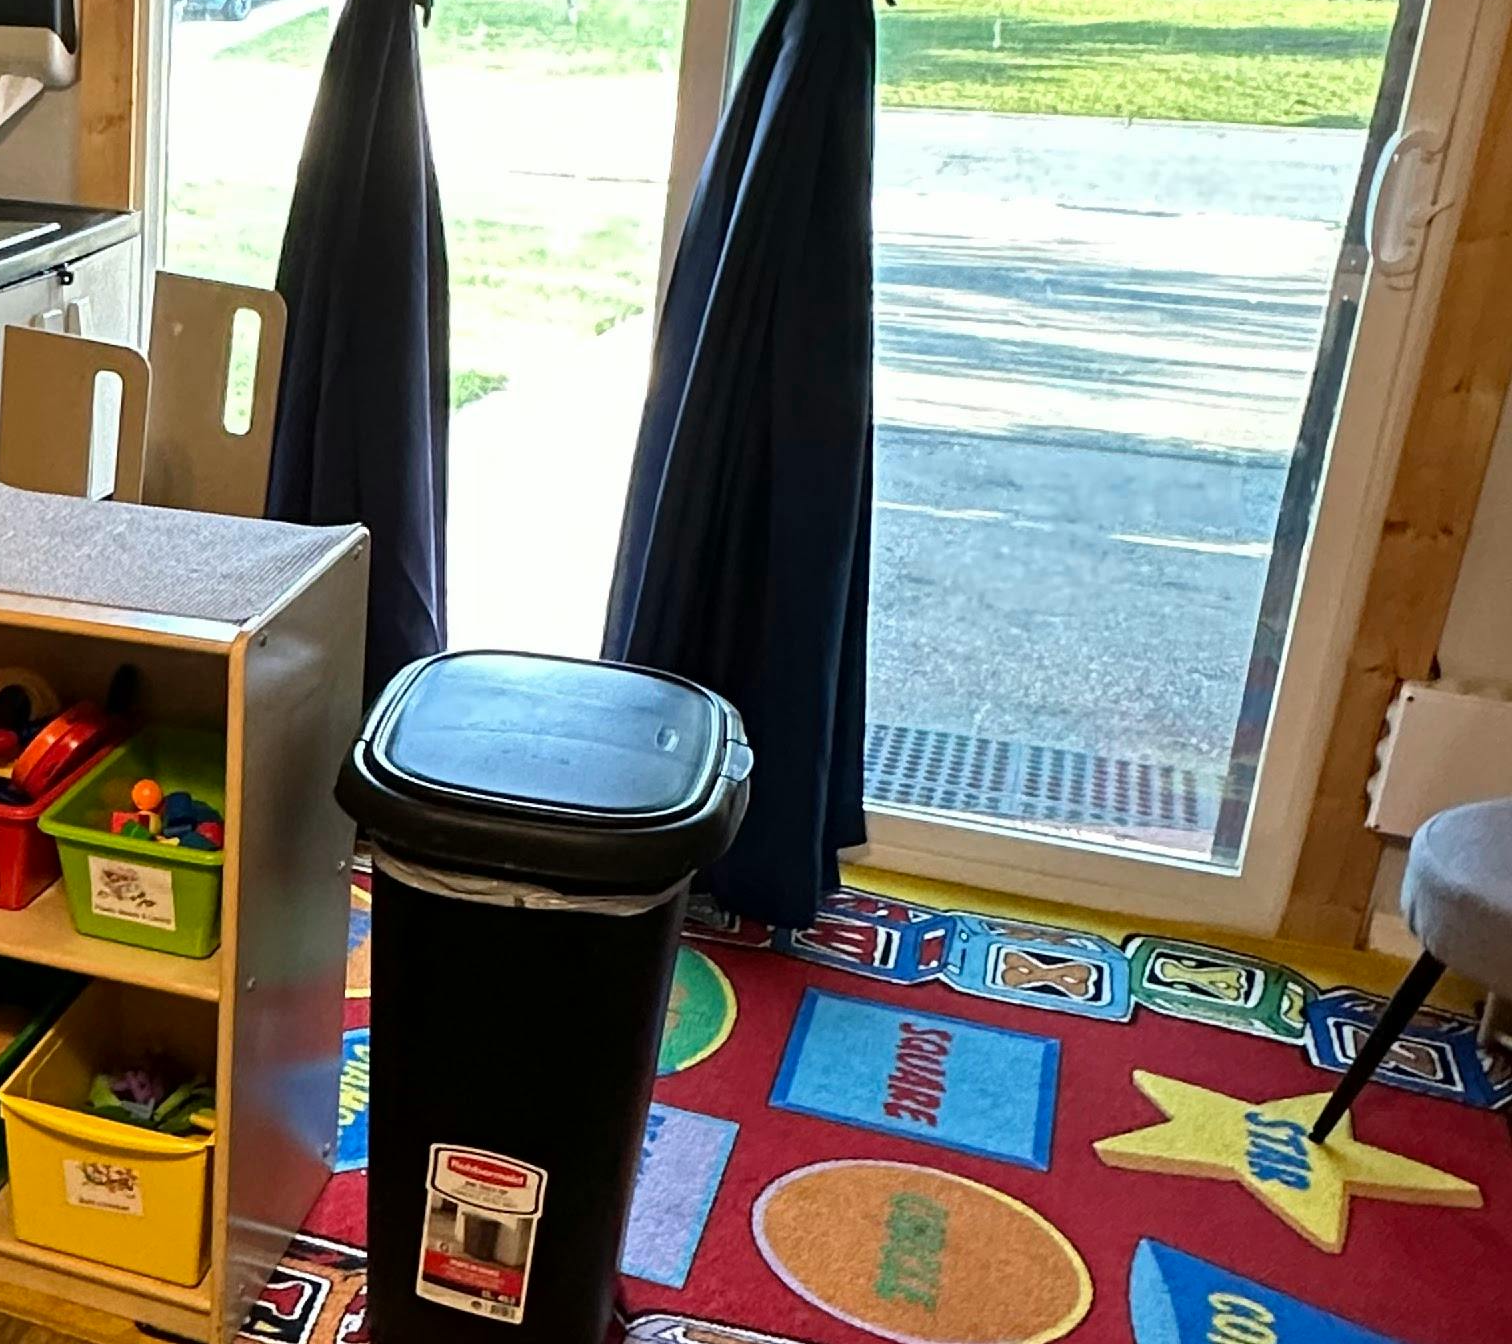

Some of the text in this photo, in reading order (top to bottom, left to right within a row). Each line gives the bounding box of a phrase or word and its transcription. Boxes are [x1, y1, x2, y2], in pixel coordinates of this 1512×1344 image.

[881, 1023, 952, 1126] SQUARE
[1245, 1112, 1312, 1190] STAR
[878, 1192, 950, 1314] CIRCLE
